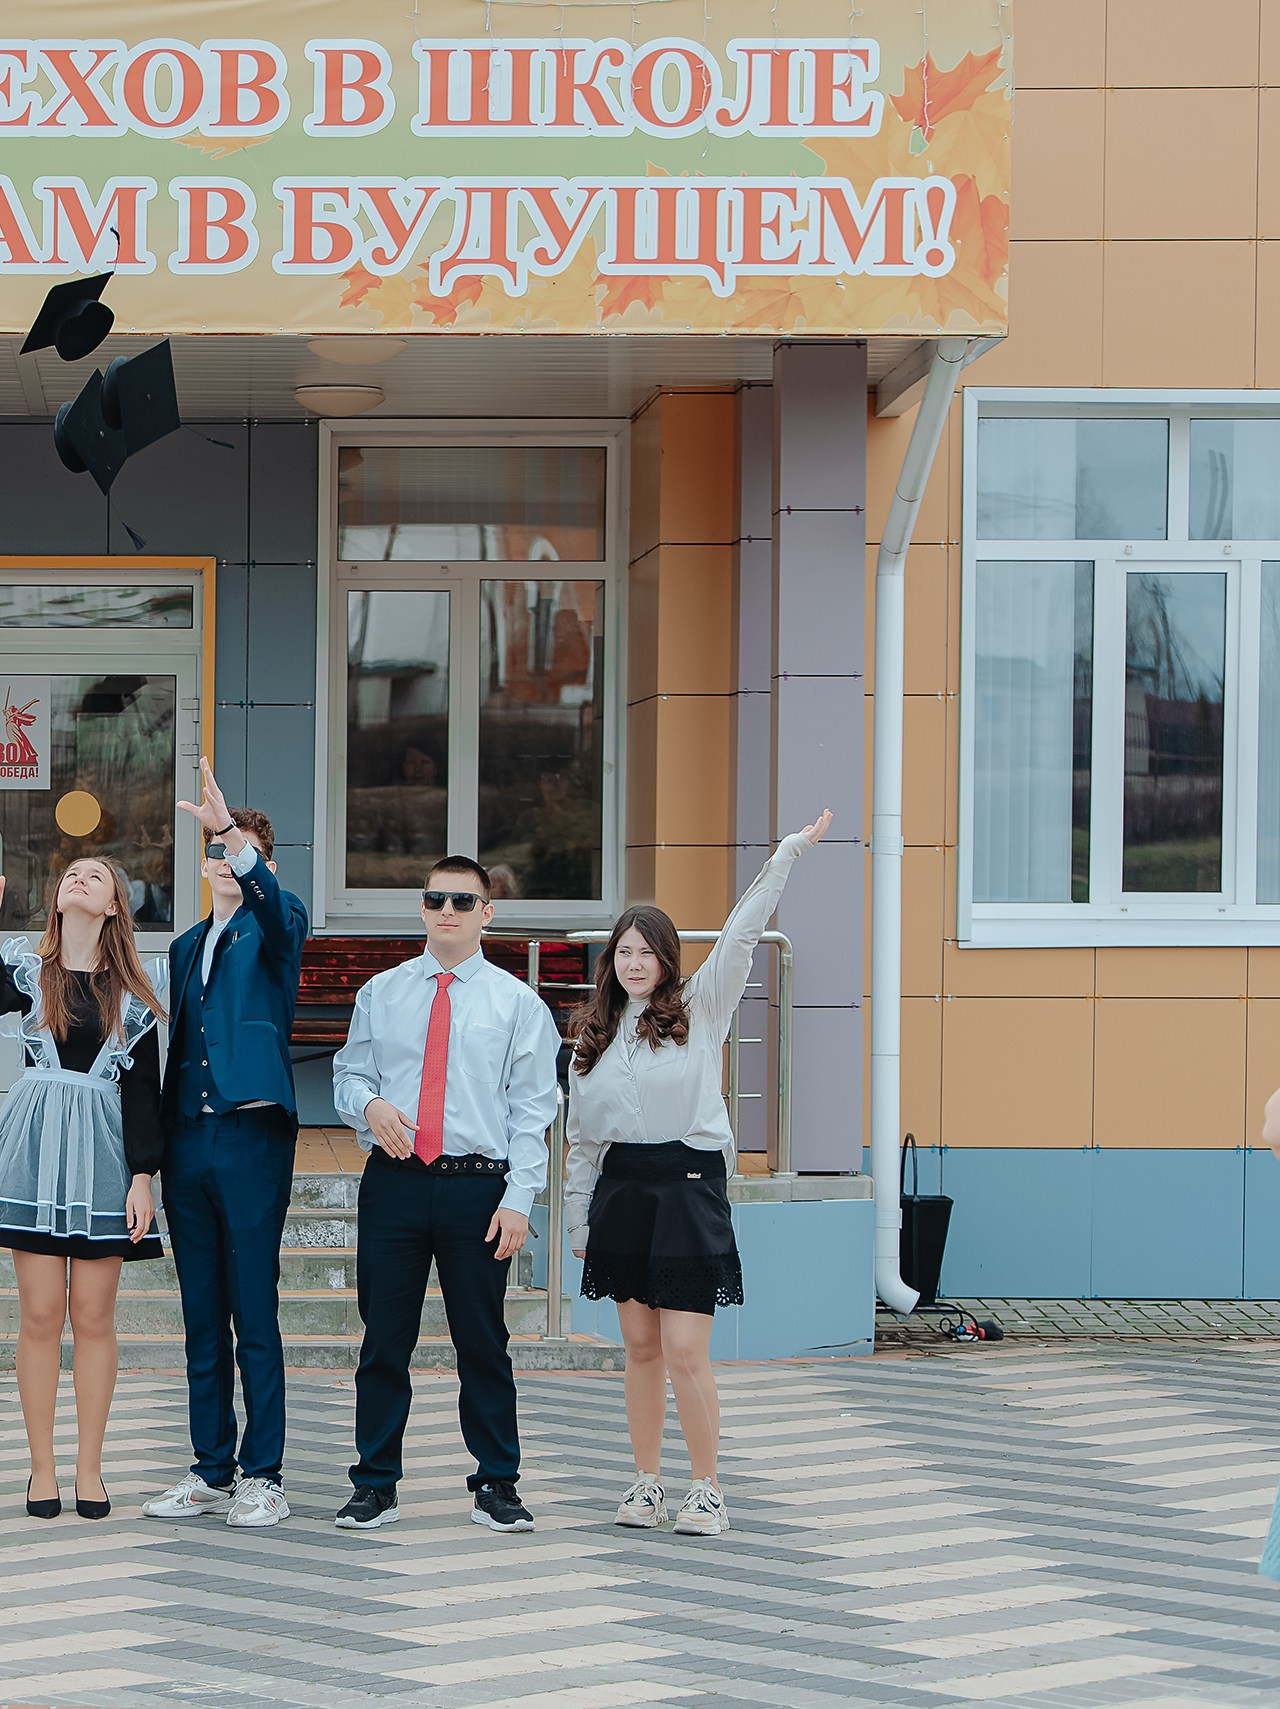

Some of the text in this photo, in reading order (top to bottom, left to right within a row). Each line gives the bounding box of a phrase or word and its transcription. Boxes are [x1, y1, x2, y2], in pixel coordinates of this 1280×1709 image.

[313, 48, 385, 127] В
[421, 47, 875, 128] ШКОЛЕ
[178, 187, 250, 264] В
[282, 185, 945, 288] БУДУЩЕМ!
